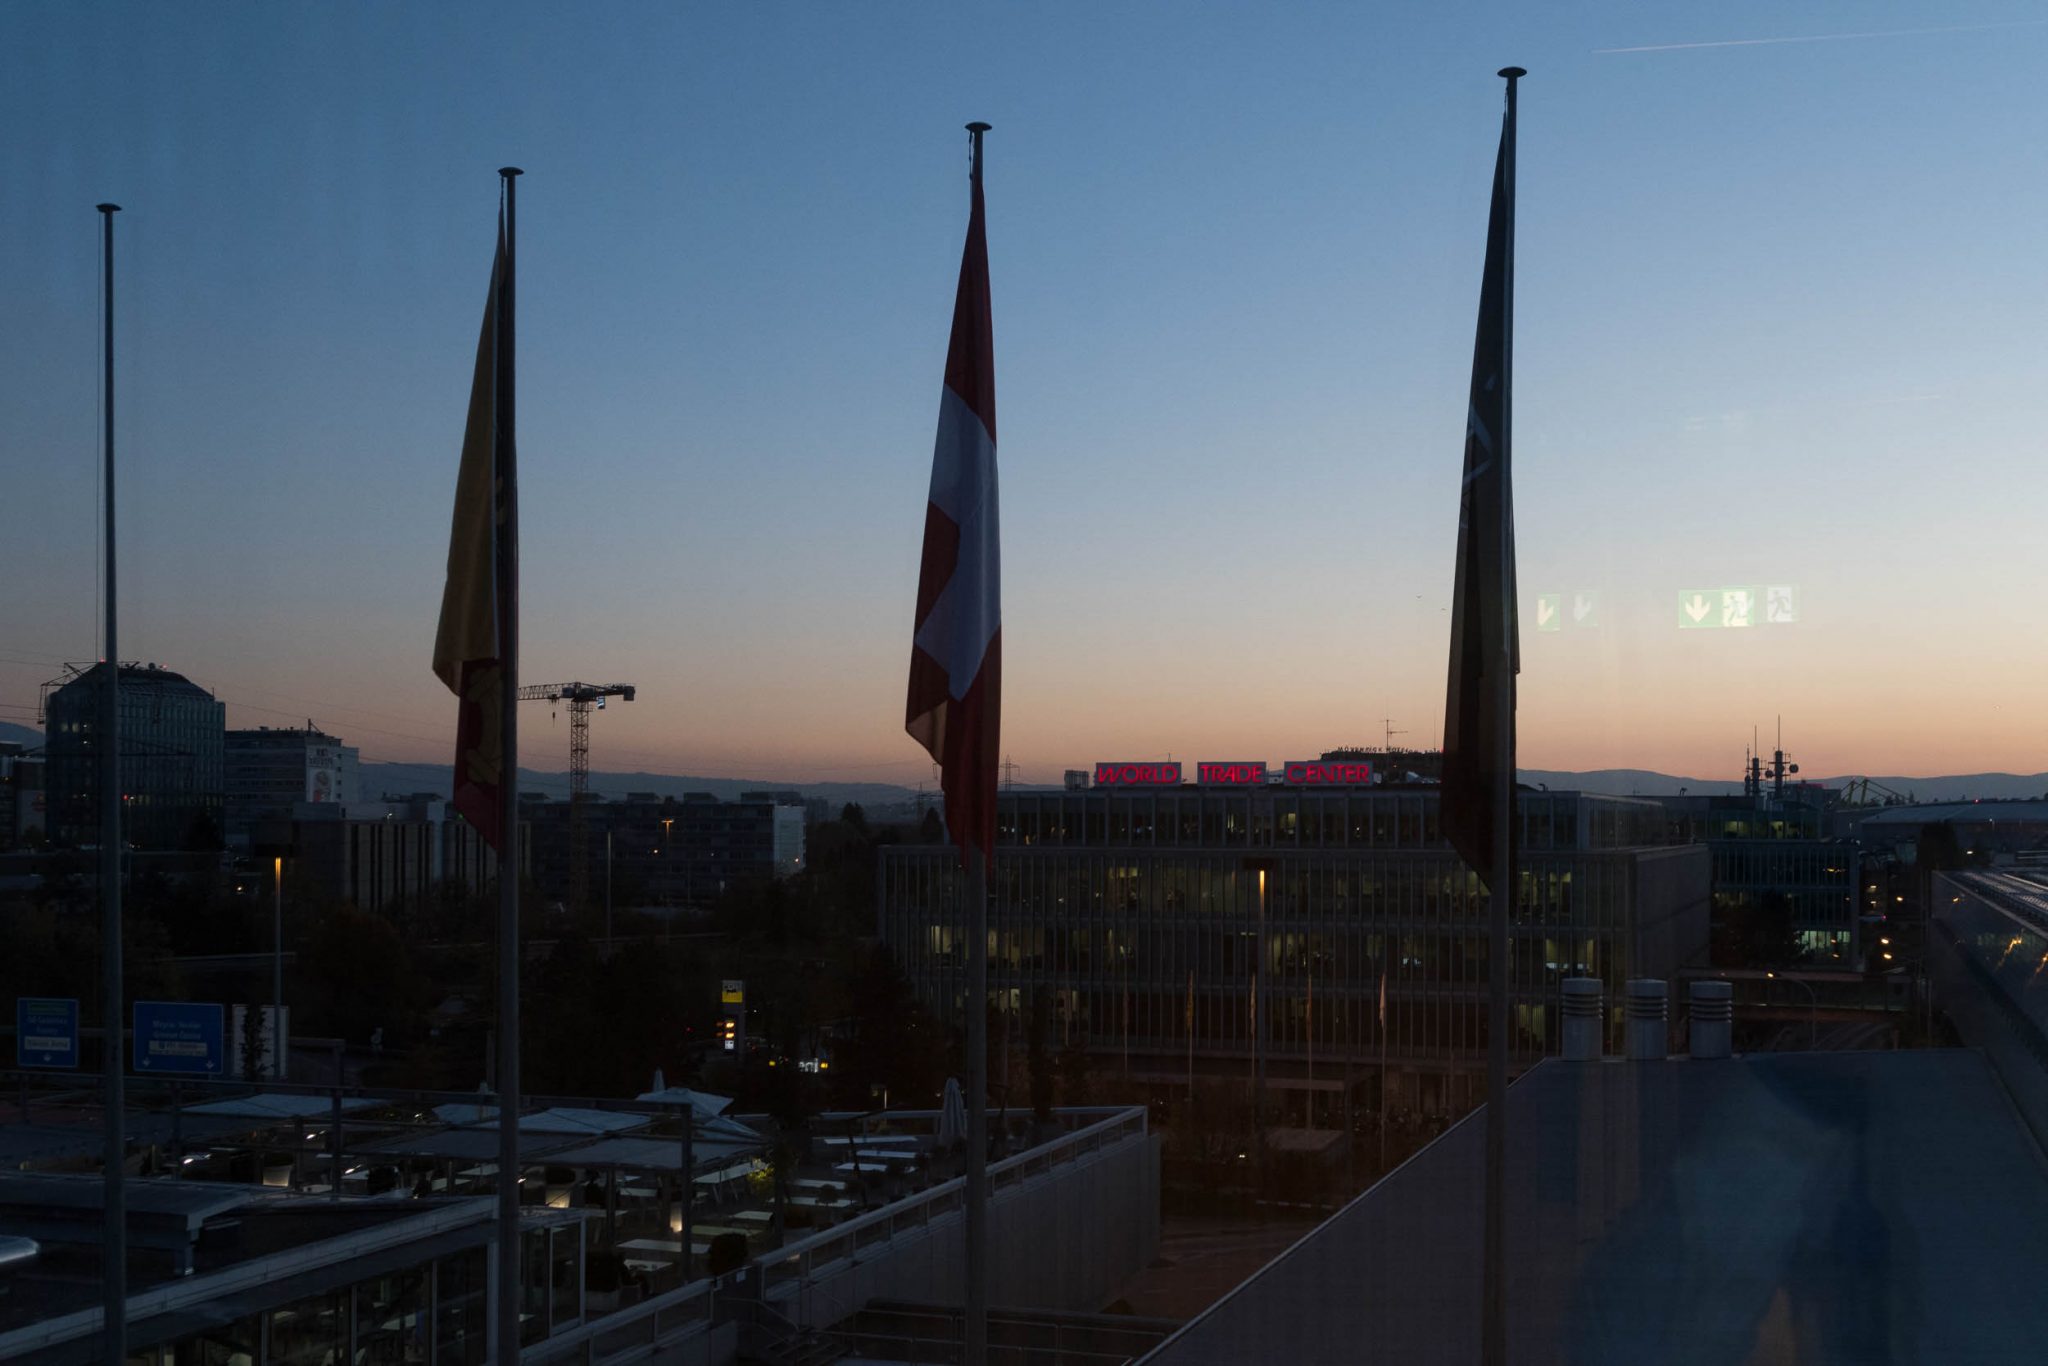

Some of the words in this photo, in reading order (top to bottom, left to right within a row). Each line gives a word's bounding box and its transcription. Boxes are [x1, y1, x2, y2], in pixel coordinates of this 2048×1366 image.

[1097, 765, 1178, 784] WORLD
[1200, 764, 1262, 784] TRADE
[1286, 764, 1370, 784] CENTER
